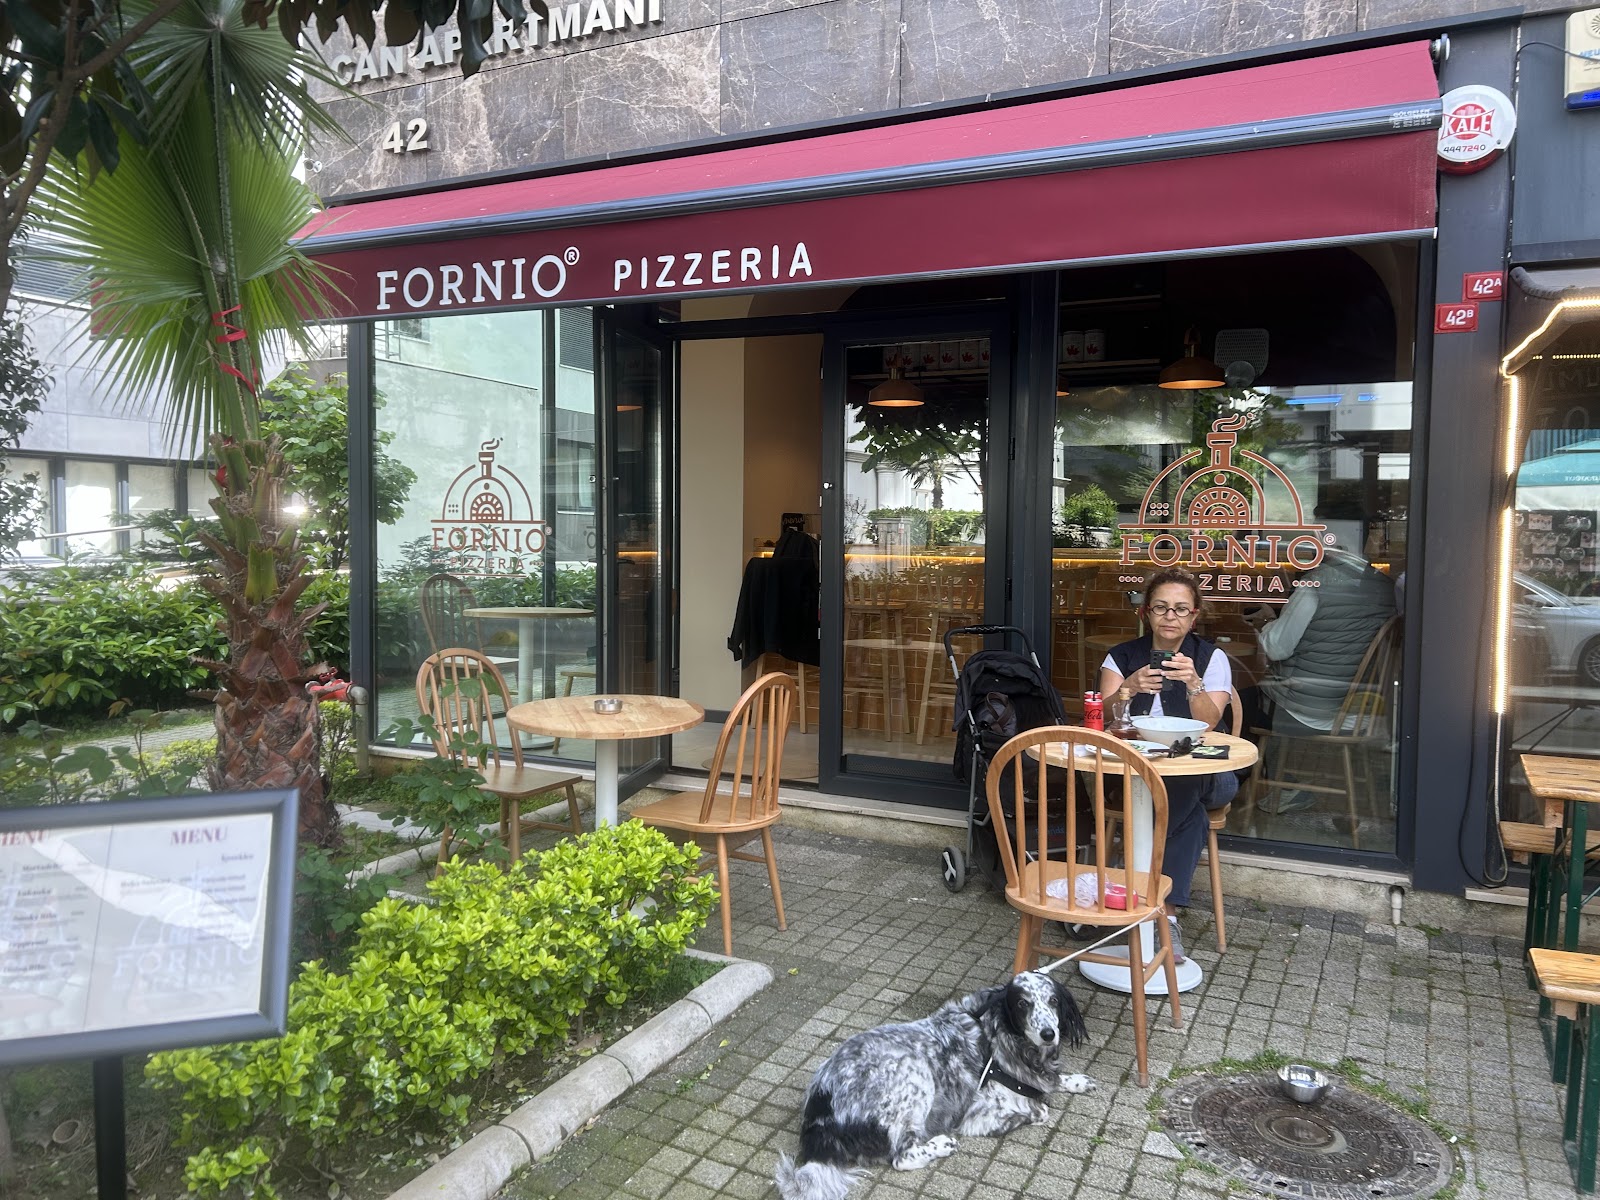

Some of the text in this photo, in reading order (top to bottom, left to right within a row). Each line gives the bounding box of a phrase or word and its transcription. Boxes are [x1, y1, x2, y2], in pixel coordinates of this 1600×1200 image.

[331, 0, 660, 86] CAN APRTMANI
[1441, 109, 1495, 139] KALE
[382, 117, 429, 154] 42
[1443, 144, 1486, 153] 4447240
[613, 242, 813, 292] PIZZERIA
[1445, 308, 1474, 326] 42B
[450, 556, 525, 570] PIZZERIA
[1198, 574, 1285, 592] ZERIA
[169, 825, 229, 847] MENU
